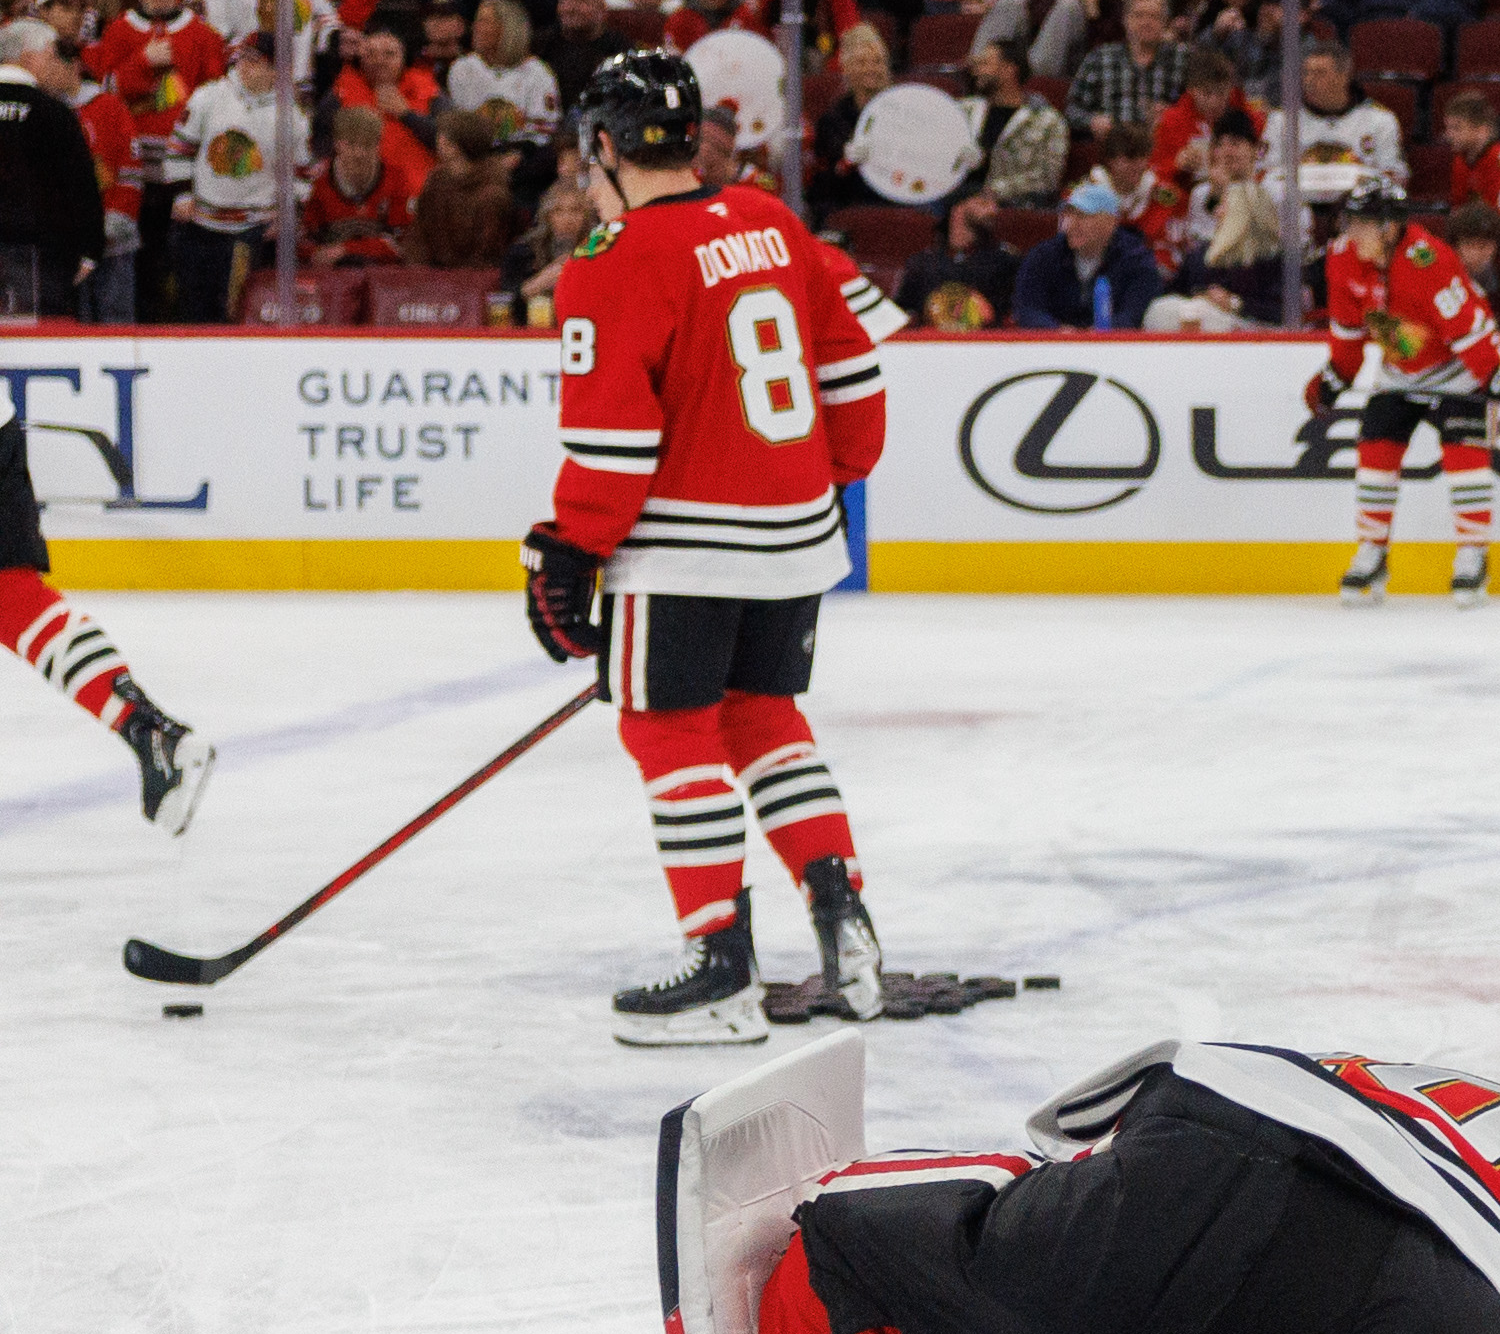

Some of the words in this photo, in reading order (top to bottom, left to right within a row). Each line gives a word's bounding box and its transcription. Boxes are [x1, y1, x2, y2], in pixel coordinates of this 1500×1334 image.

[694, 227, 792, 288] DONATO
[560, 316, 597, 376] 8
[725, 282, 818, 446] 8
[298, 424, 482, 460] TRUST
[303, 476, 424, 511] LIFE
